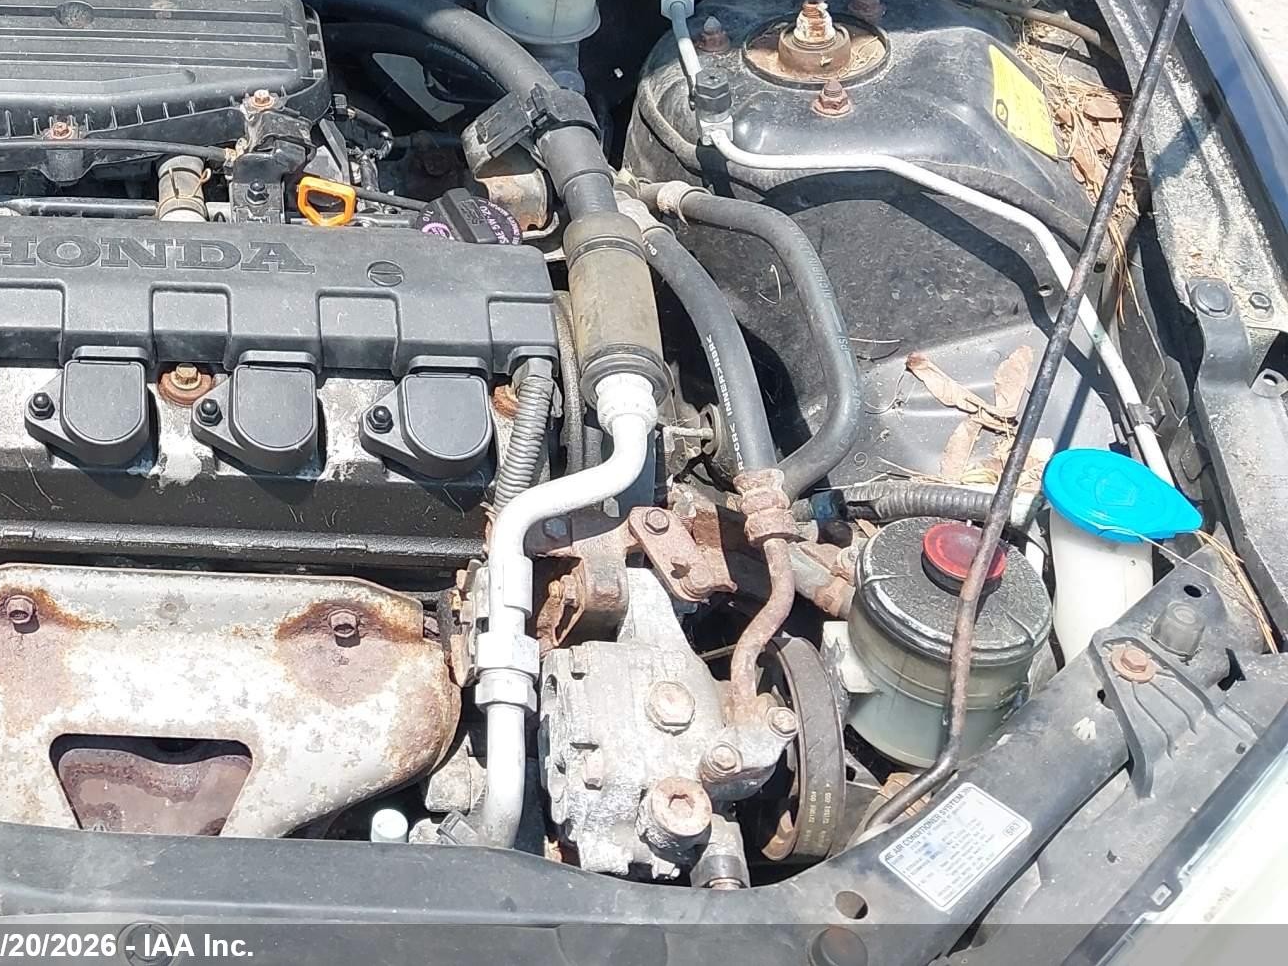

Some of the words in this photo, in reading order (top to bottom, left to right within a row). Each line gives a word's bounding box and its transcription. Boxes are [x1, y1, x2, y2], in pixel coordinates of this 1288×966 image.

[422, 208, 433, 222] OIL
[478, 204, 500, 231] 5W-20
[494, 229, 510, 244] SAE
[901, 811, 942, 847] CONDITIONER
[937, 791, 964, 816] SYSTEM
